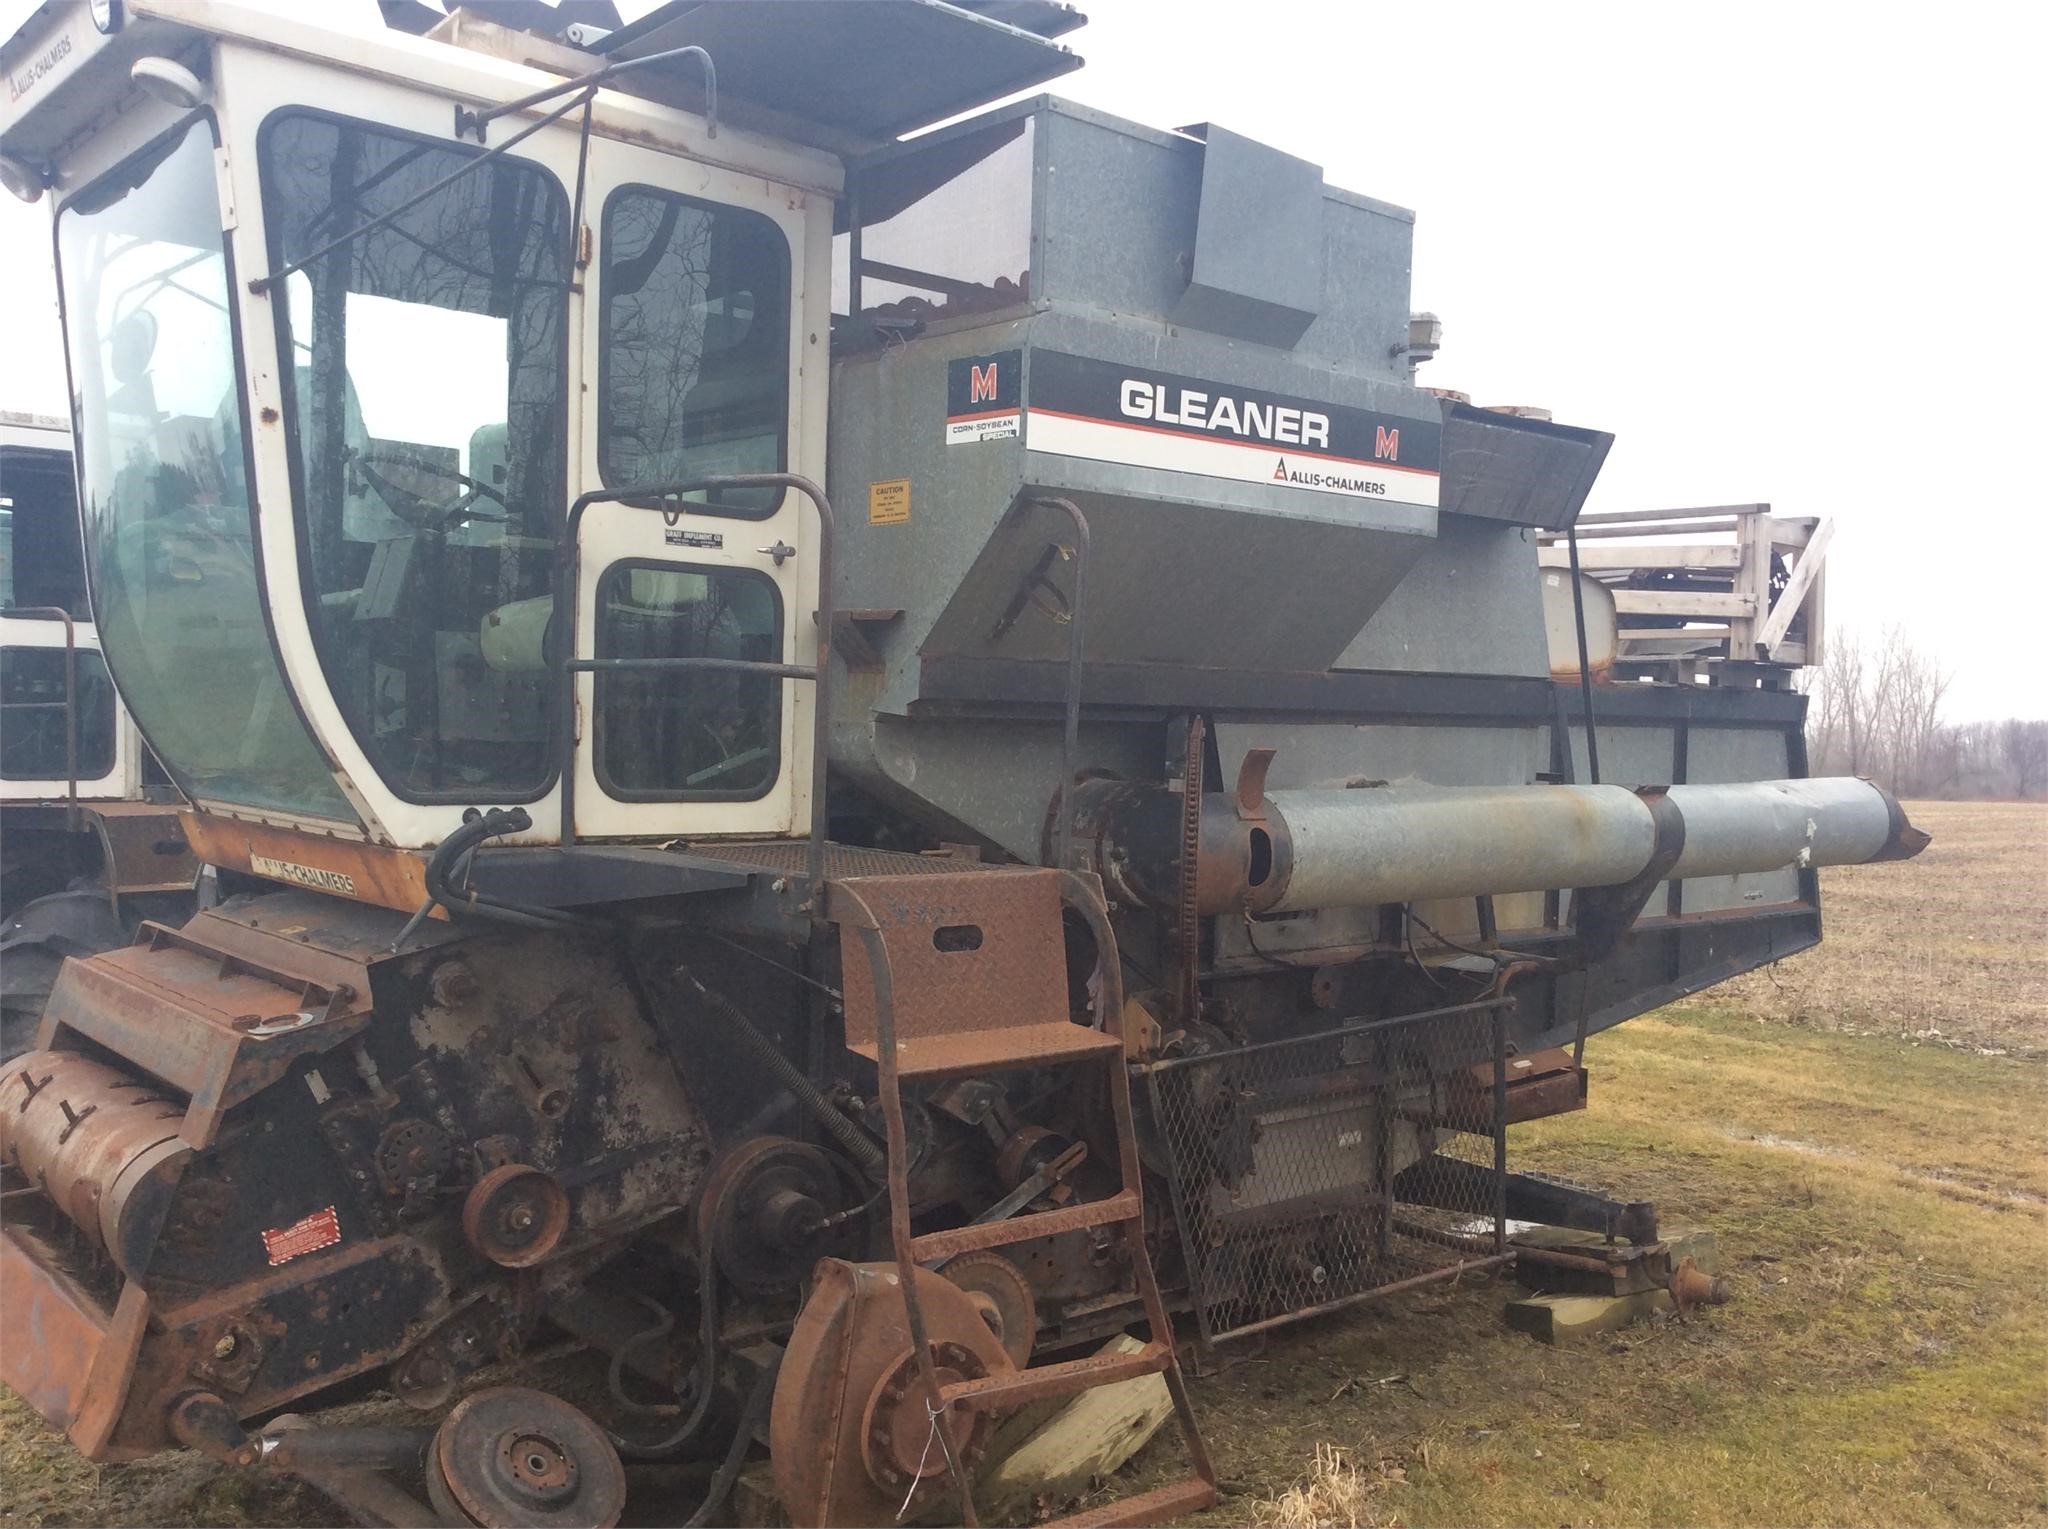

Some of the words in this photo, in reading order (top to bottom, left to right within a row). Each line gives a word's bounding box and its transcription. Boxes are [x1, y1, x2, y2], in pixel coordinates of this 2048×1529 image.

[17, 34, 72, 96] ALLIS-CHALMERS
[971, 363, 997, 403] M
[1120, 379, 1329, 448] GLEANER
[1375, 425, 1399, 461] M
[875, 486, 904, 495] CAUTION
[1290, 471, 1386, 495] ALLIS-CHALMERS
